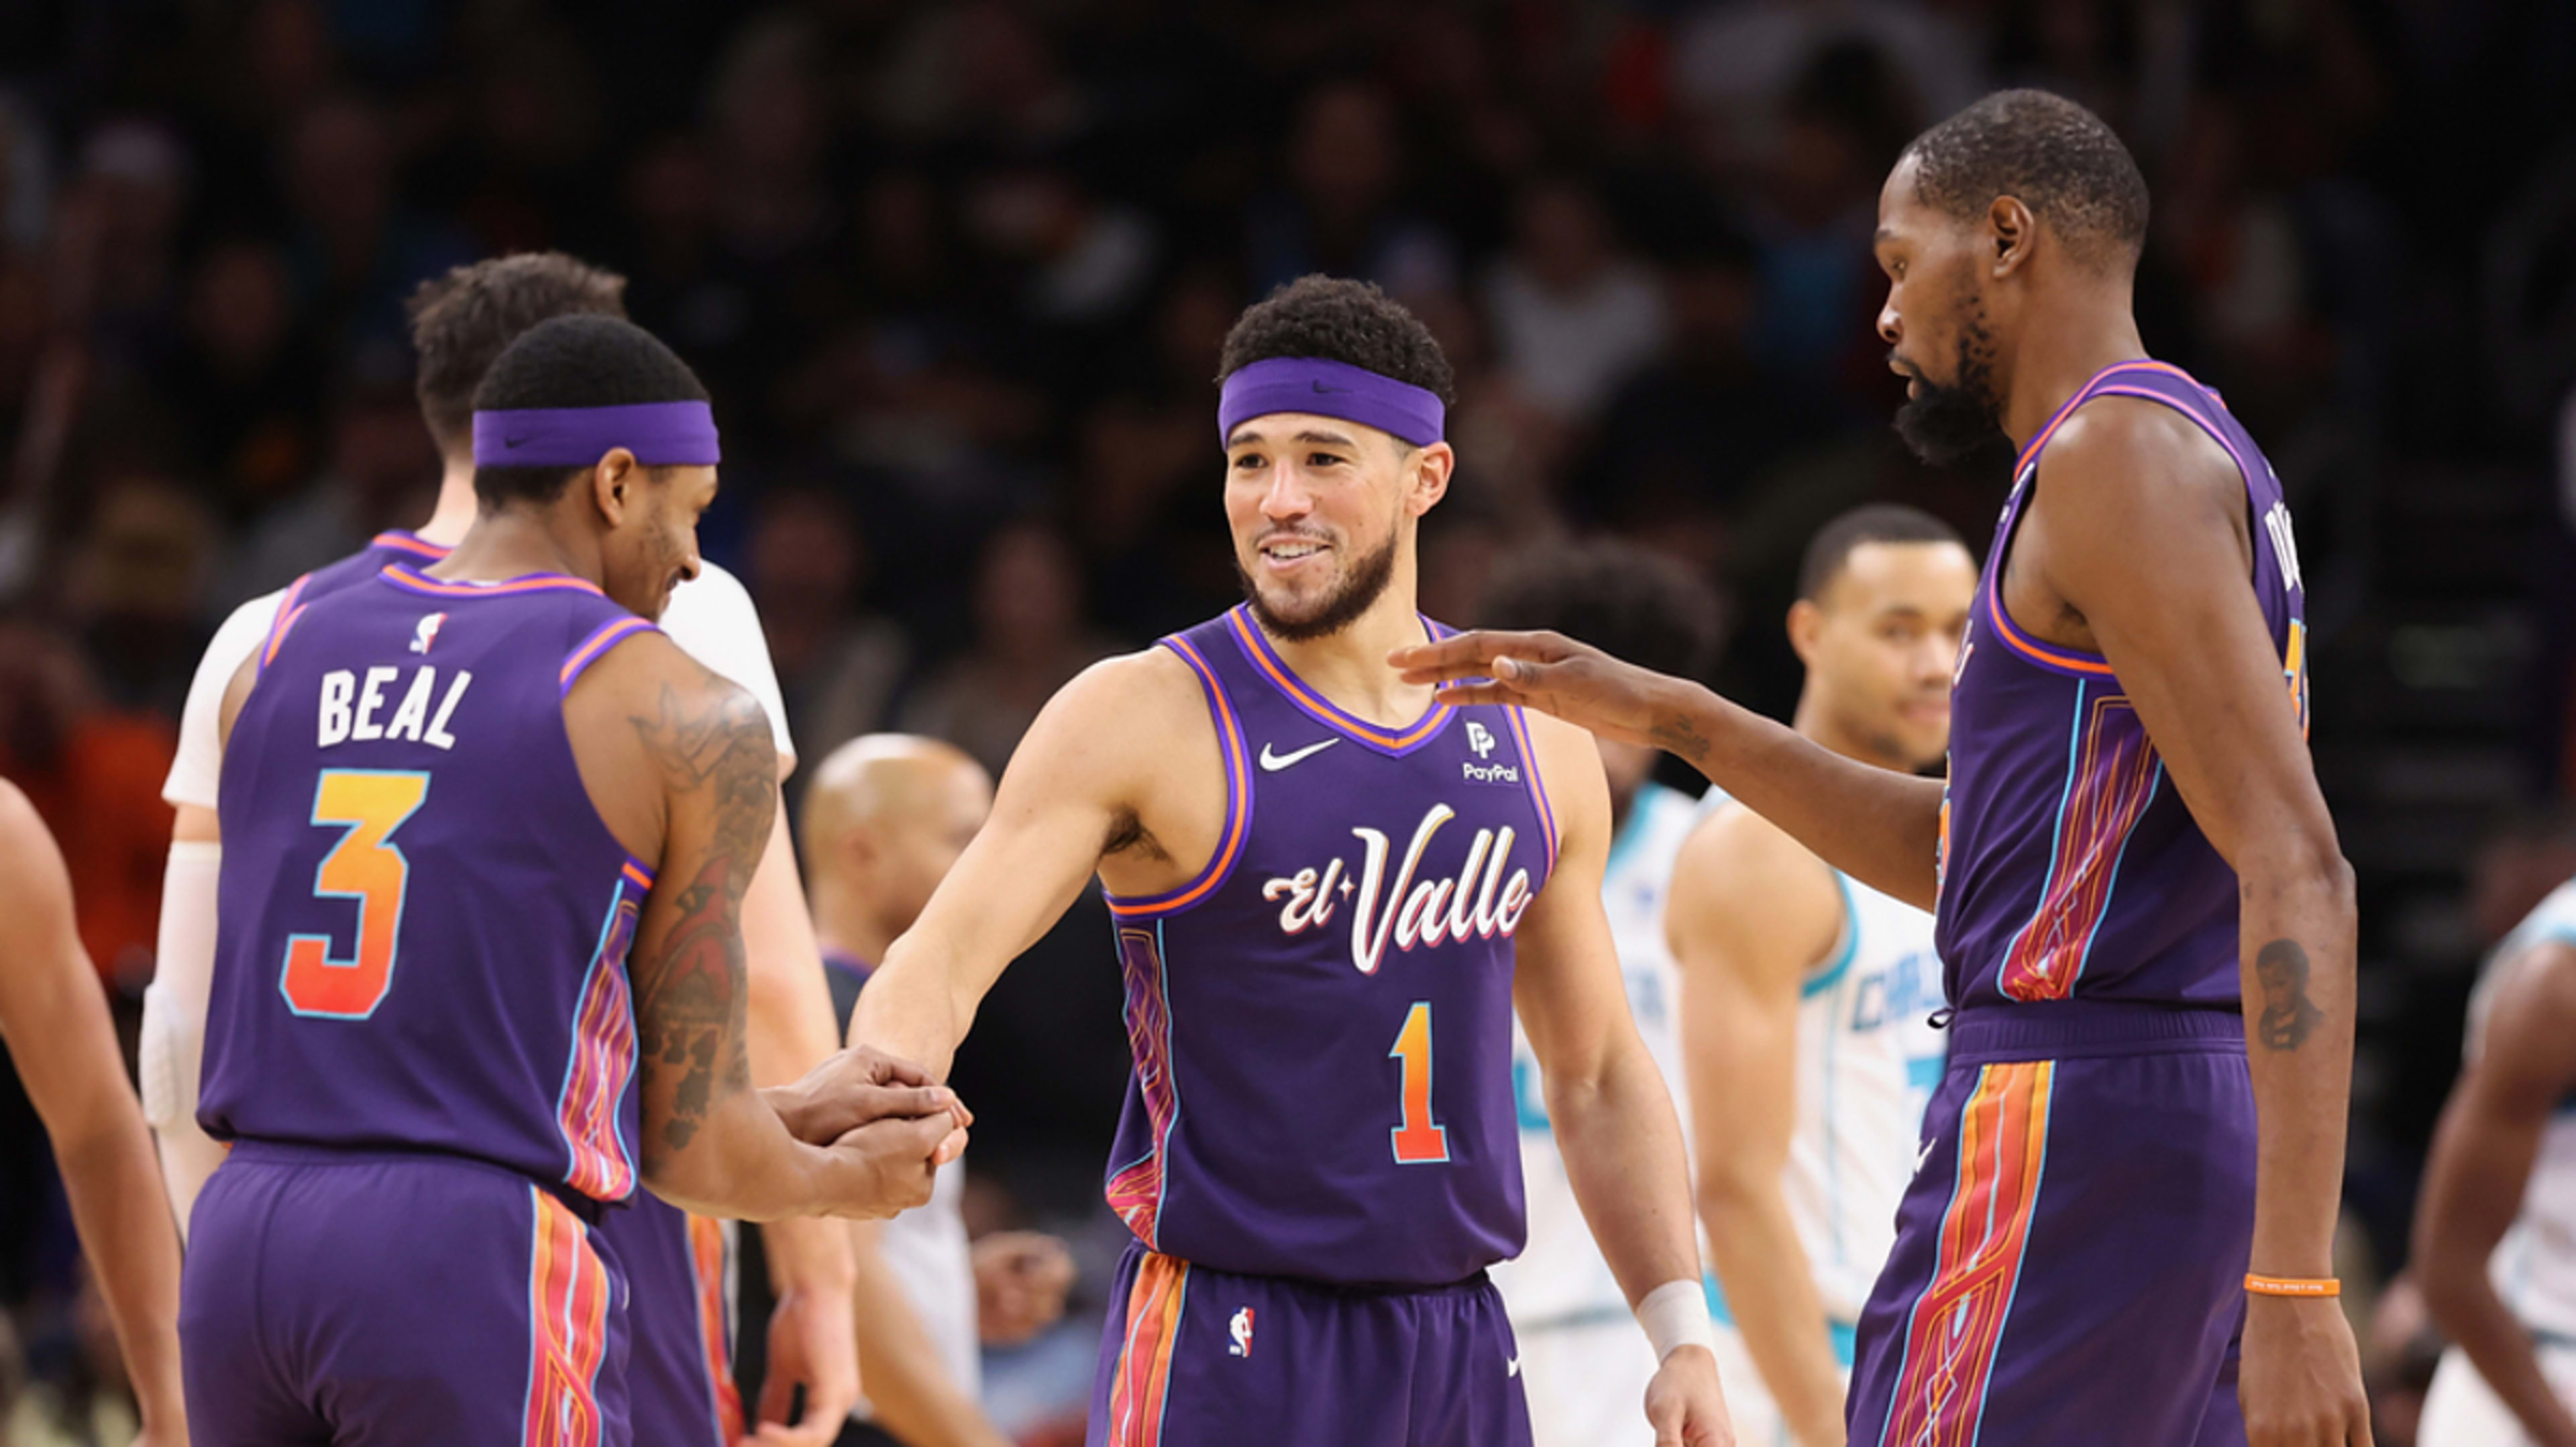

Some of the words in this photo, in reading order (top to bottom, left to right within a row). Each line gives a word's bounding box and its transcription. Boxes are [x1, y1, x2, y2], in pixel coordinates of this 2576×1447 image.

[317, 665, 472, 750] BEAL
[1462, 762, 1519, 784] PayPal
[279, 767, 431, 1020] 3
[1262, 857, 1344, 933] El
[1351, 802, 1534, 975] Valle
[1388, 1001, 1451, 1165] 1
